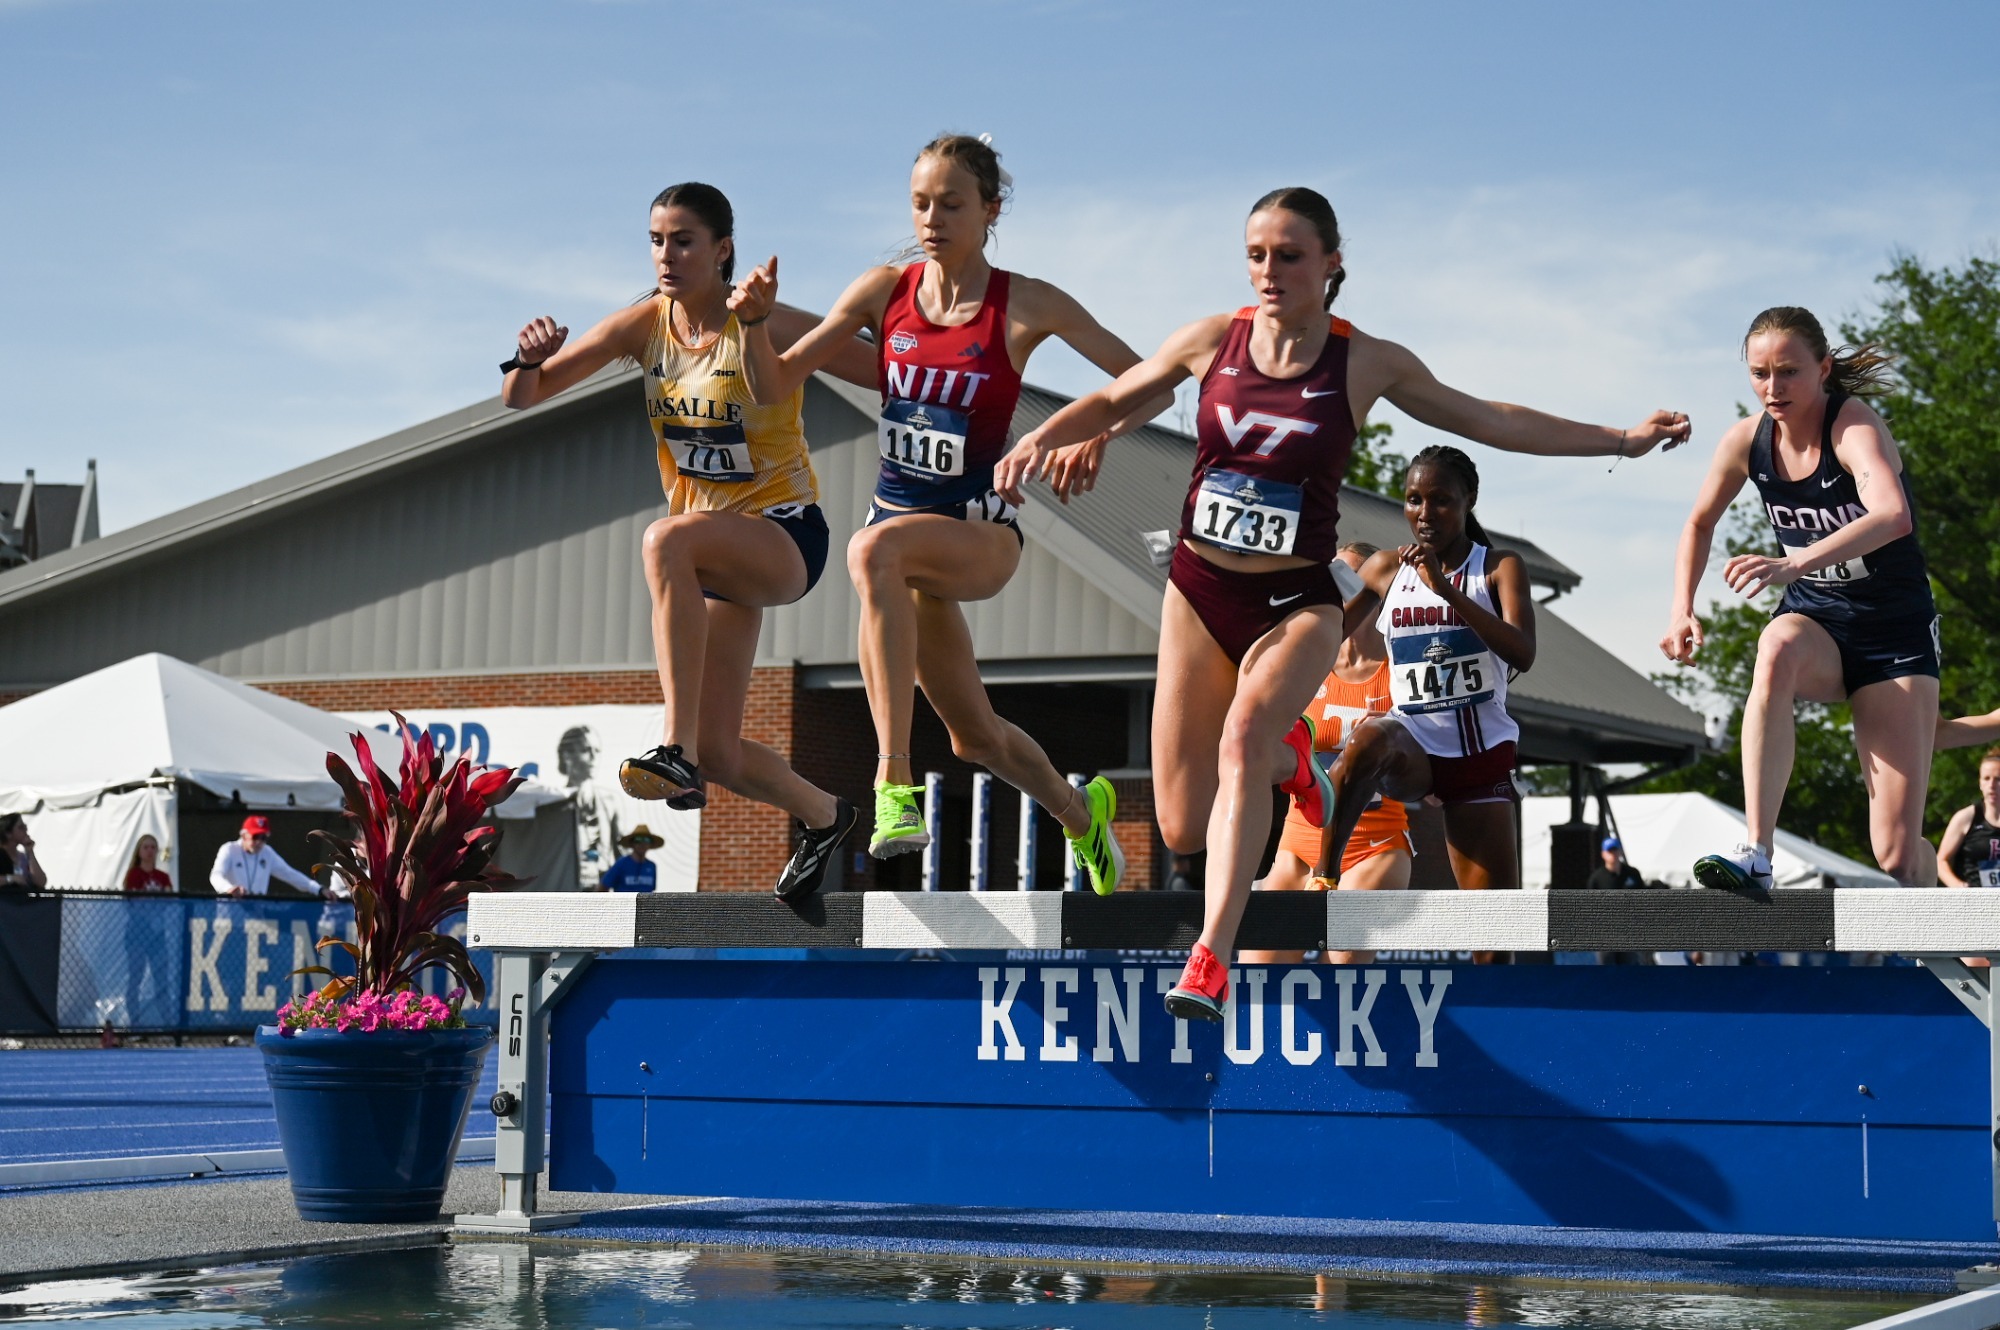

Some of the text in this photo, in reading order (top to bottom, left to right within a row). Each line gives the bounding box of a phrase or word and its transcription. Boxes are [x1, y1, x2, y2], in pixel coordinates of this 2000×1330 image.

[887, 360, 991, 408] NJIT
[1218, 366, 1240, 376] ACC
[887, 427, 953, 473] 1116
[1214, 402, 1324, 459] VT
[684, 443, 736, 471] 770
[1203, 501, 1288, 551] 1733
[1406, 658, 1483, 701] 1475
[508, 993, 523, 1057] UCS
